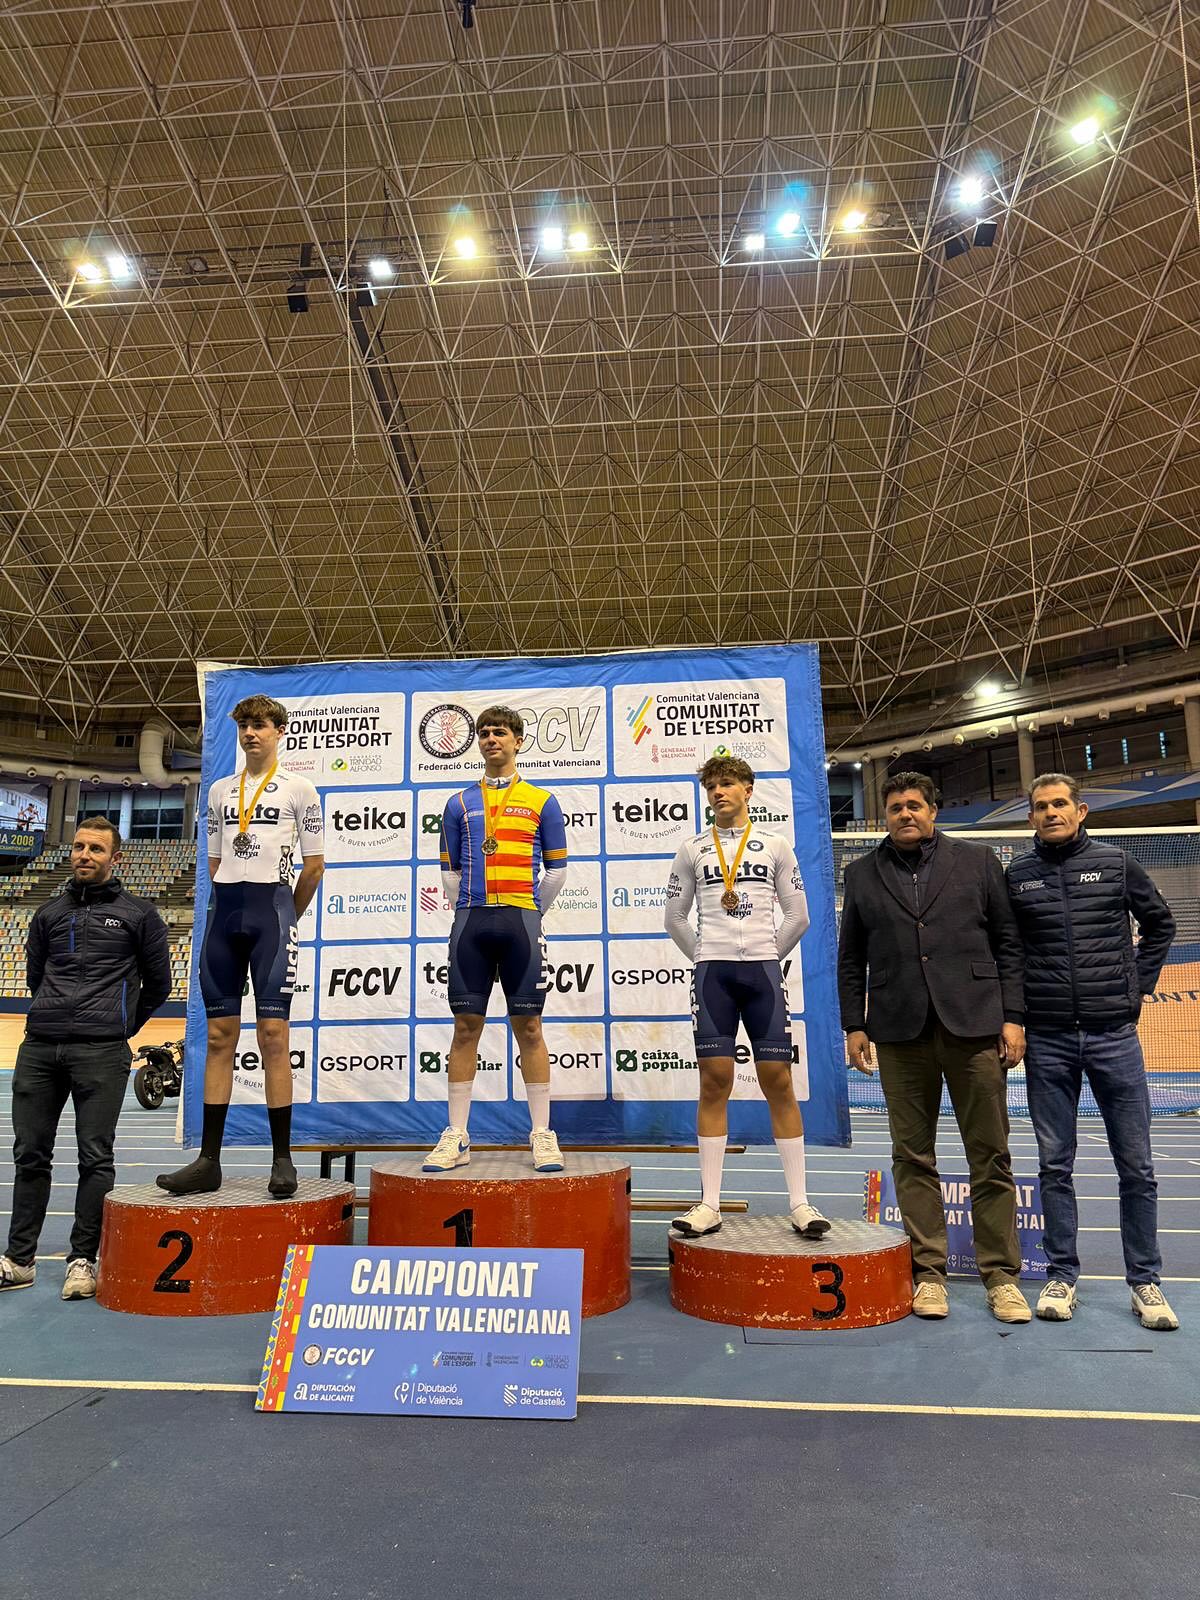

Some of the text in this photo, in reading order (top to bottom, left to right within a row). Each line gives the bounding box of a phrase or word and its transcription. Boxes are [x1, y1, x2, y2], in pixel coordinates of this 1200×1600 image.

[656, 691, 760, 703] Comunitat Valenciana
[286, 705, 380, 718] omunitat Valenciana
[656, 703, 760, 720] COMUNITAT
[516, 706, 600, 754] CCV
[664, 719, 774, 736] DE L'ESPORT
[286, 732, 392, 751] DE L'ESPORT
[418, 762, 461, 771] Federació
[553, 758, 601, 767] Valenciana
[224, 803, 280, 819] Luta
[513, 808, 533, 816] FCCV
[612, 798, 688, 822] teika
[747, 804, 768, 814] ixa
[331, 806, 406, 831] teika
[563, 812, 598, 828] ORT
[749, 812, 789, 824] pular
[619, 824, 682, 839] EL BUEN VENDING
[11, 834, 35, 847] 2008
[703, 860, 768, 880] Luta
[1080, 872, 1102, 883] FCCV
[349, 891, 407, 903] DIPUTACIÓN
[559, 887, 589, 897] utació
[348, 904, 407, 914] DE ALICANTE
[558, 900, 598, 910] València
[634, 899, 645, 907] DE
[328, 966, 402, 997] FCCV
[430, 988, 449, 1001] EL BU
[641, 1049, 679, 1060] caixa
[320, 1055, 407, 1072] GSPORT
[641, 1059, 699, 1072] popular
[234, 1075, 263, 1089] EL BUEN
[737, 1073, 757, 1083] BUEN
[443, 1208, 474, 1247] 1
[153, 1229, 193, 1294] 2
[350, 1258, 539, 1298] CAMPIONAT
[812, 1262, 847, 1320] 3
[308, 1303, 571, 1336] COMUNITAT VALENCIANA
[322, 1347, 375, 1366] FCCV
[311, 1383, 356, 1393] DIPUTACIÓN
[417, 1382, 458, 1395] Diputació
[521, 1387, 563, 1398] Diputació
[309, 1393, 355, 1402] DE ALICANTE
[416, 1395, 464, 1406] de València
[520, 1396, 566, 1407] de Castelló
